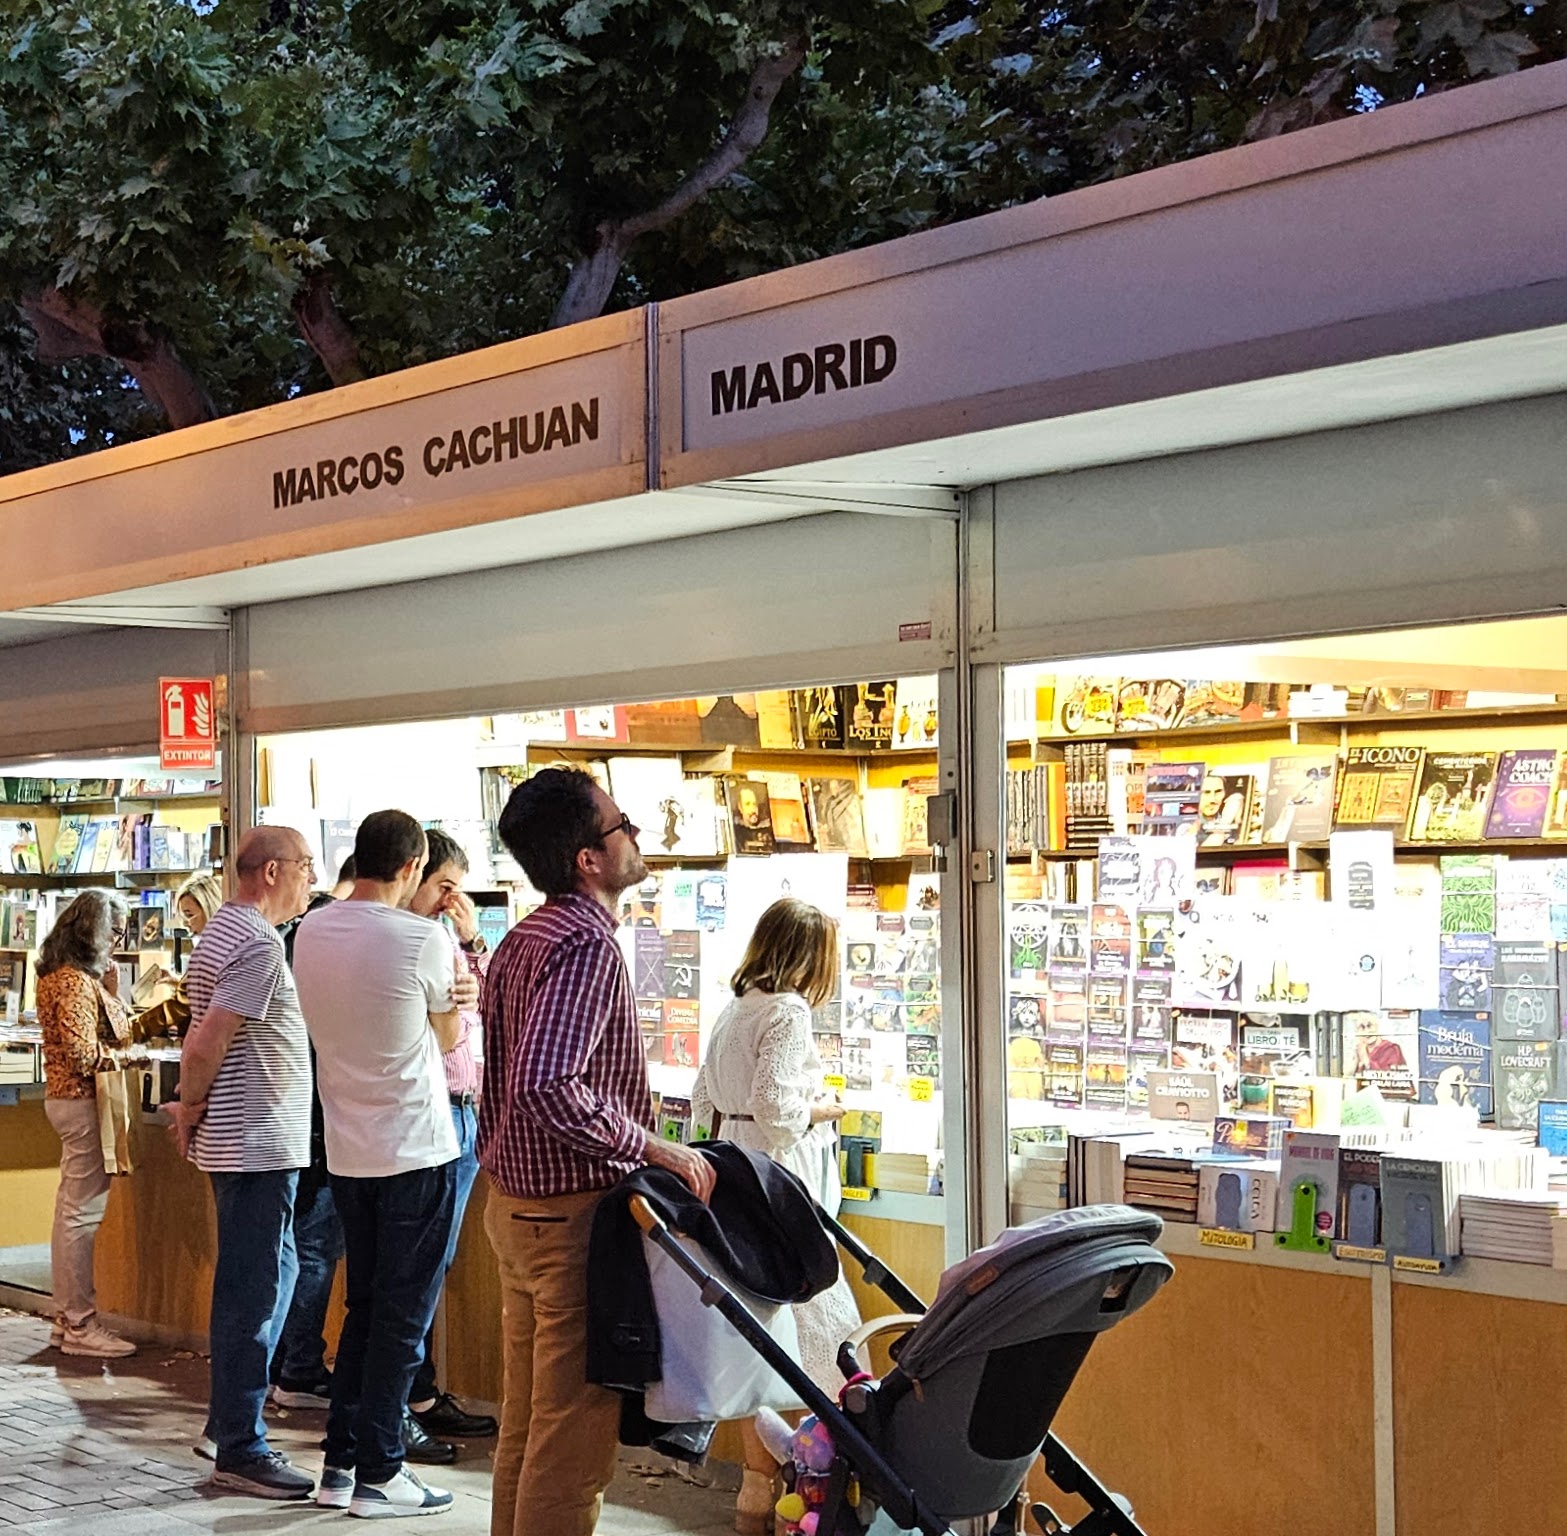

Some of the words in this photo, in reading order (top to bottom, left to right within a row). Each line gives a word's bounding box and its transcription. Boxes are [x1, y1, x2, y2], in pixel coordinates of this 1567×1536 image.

[711, 333, 897, 416] MADRID
[272, 446, 405, 509] MARCOS
[422, 397, 600, 478] CACHUAN
[848, 724, 872, 738] LOS
[163, 750, 211, 761] EXTINTOR
[1361, 747, 1420, 764] ICONO
[1512, 758, 1554, 772] ASTRO
[670, 1007, 695, 1017] DIVINA
[667, 1015, 699, 1025] COMEDIA
[1246, 1035, 1278, 1046] LIBRO
[1282, 1034, 1296, 1046] TÉ
[1437, 1026, 1474, 1044] Bruja
[1427, 1044, 1484, 1056] moderna
[1517, 1046, 1533, 1057] H.P.
[1500, 1056, 1552, 1068] LOVECRAFT
[1169, 1075, 1194, 1087] SAÚL
[1343, 1152, 1353, 1162] EL
[1386, 1157, 1396, 1166] LA
